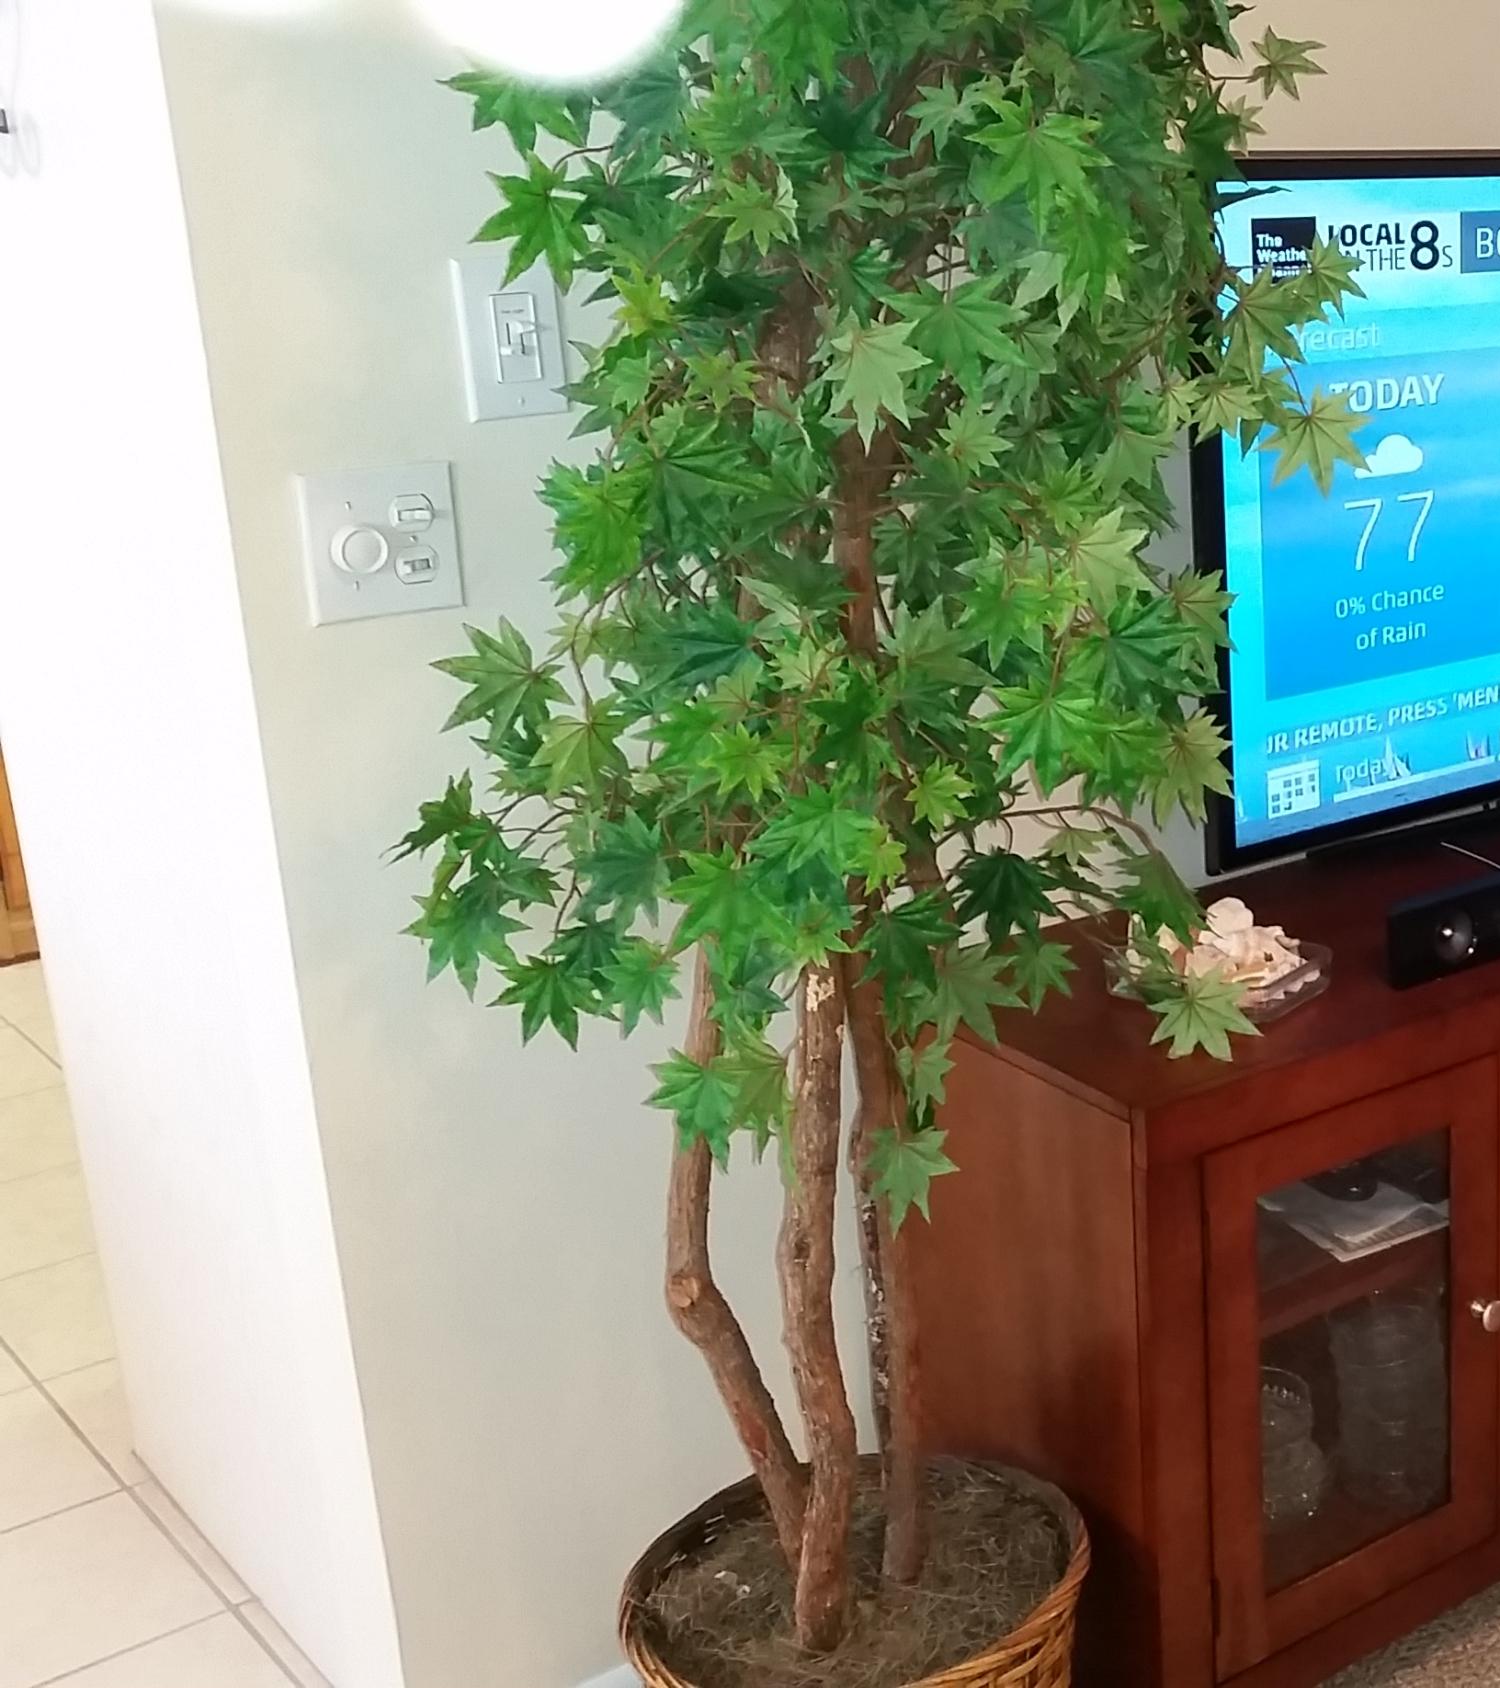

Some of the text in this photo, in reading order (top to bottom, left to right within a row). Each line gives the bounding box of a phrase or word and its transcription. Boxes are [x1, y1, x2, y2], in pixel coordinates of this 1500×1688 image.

[1256, 233, 1284, 248] The
[1256, 247, 1307, 265] Weathe
[1366, 248, 1405, 272] THE
[1300, 322, 1379, 352] recast
[1344, 489, 1435, 571] 77
[1335, 584, 1445, 619] 0% Chance
[1356, 621, 1427, 651] of Rain
[1294, 712, 1384, 748] REMOTE,
[1388, 697, 1448, 727] PRESS
